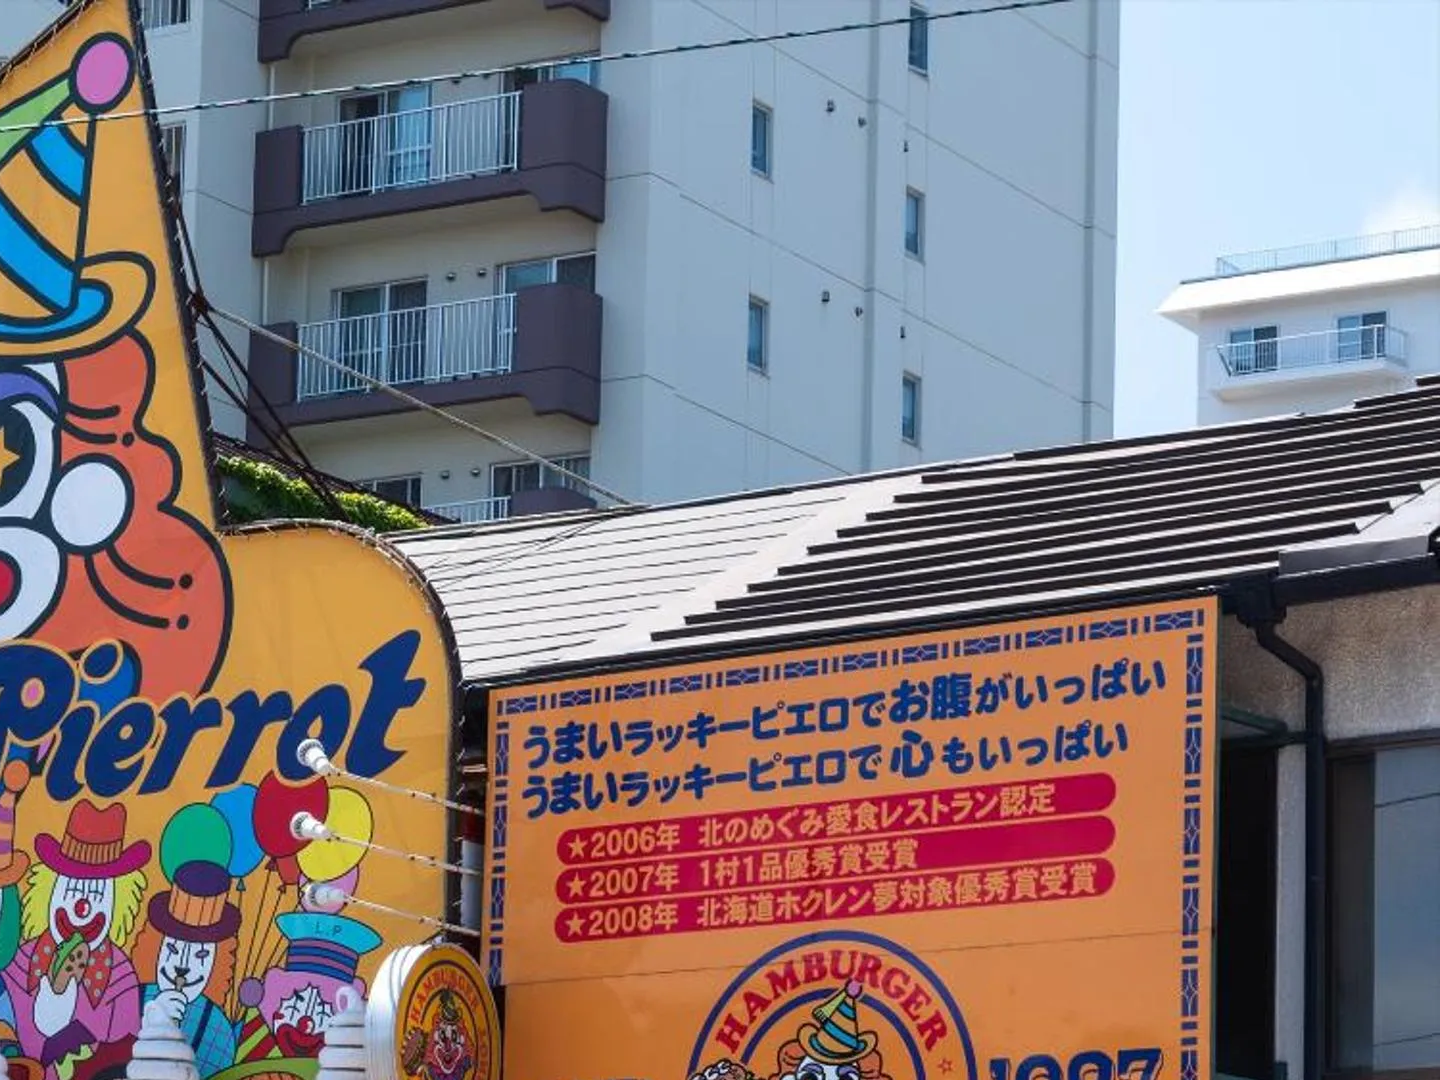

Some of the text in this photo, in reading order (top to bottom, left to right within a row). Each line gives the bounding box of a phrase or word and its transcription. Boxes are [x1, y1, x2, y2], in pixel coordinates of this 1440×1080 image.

[523, 657, 1166, 770] うまいラッキーピエロでお腹がいっぱい
[521, 720, 1129, 819] うまいラッキーピエロで心もいっぱい
[590, 783, 1056, 858] 2006年 北のめぐみ愛食レストラン認定
[587, 861, 1097, 936] 2008年 北海道ホクレン夢対象優秀賞受賞
[588, 838, 919, 898] 2007年 1村1品優秀賞受賞
[715, 949, 948, 1054] HAMBURGER
